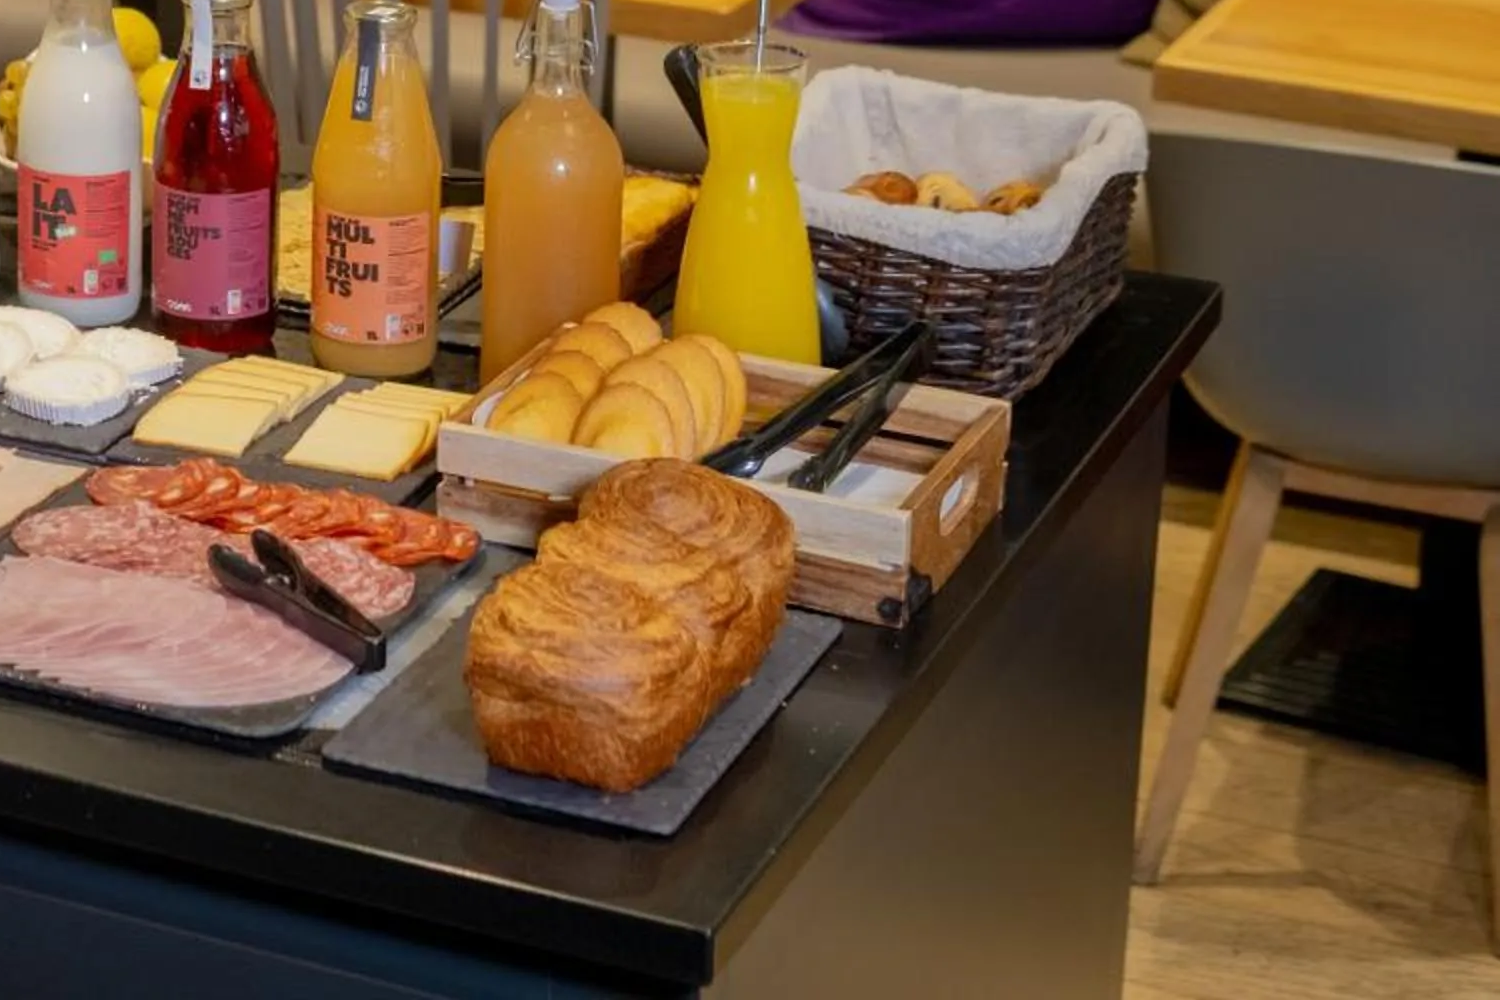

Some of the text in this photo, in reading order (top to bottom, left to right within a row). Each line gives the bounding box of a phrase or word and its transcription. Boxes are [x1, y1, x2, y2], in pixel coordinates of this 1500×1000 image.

[32, 181, 78, 217] LA
[32, 210, 67, 241] IT
[325, 256, 380, 284] FRUI
[325, 275, 352, 299] TS
